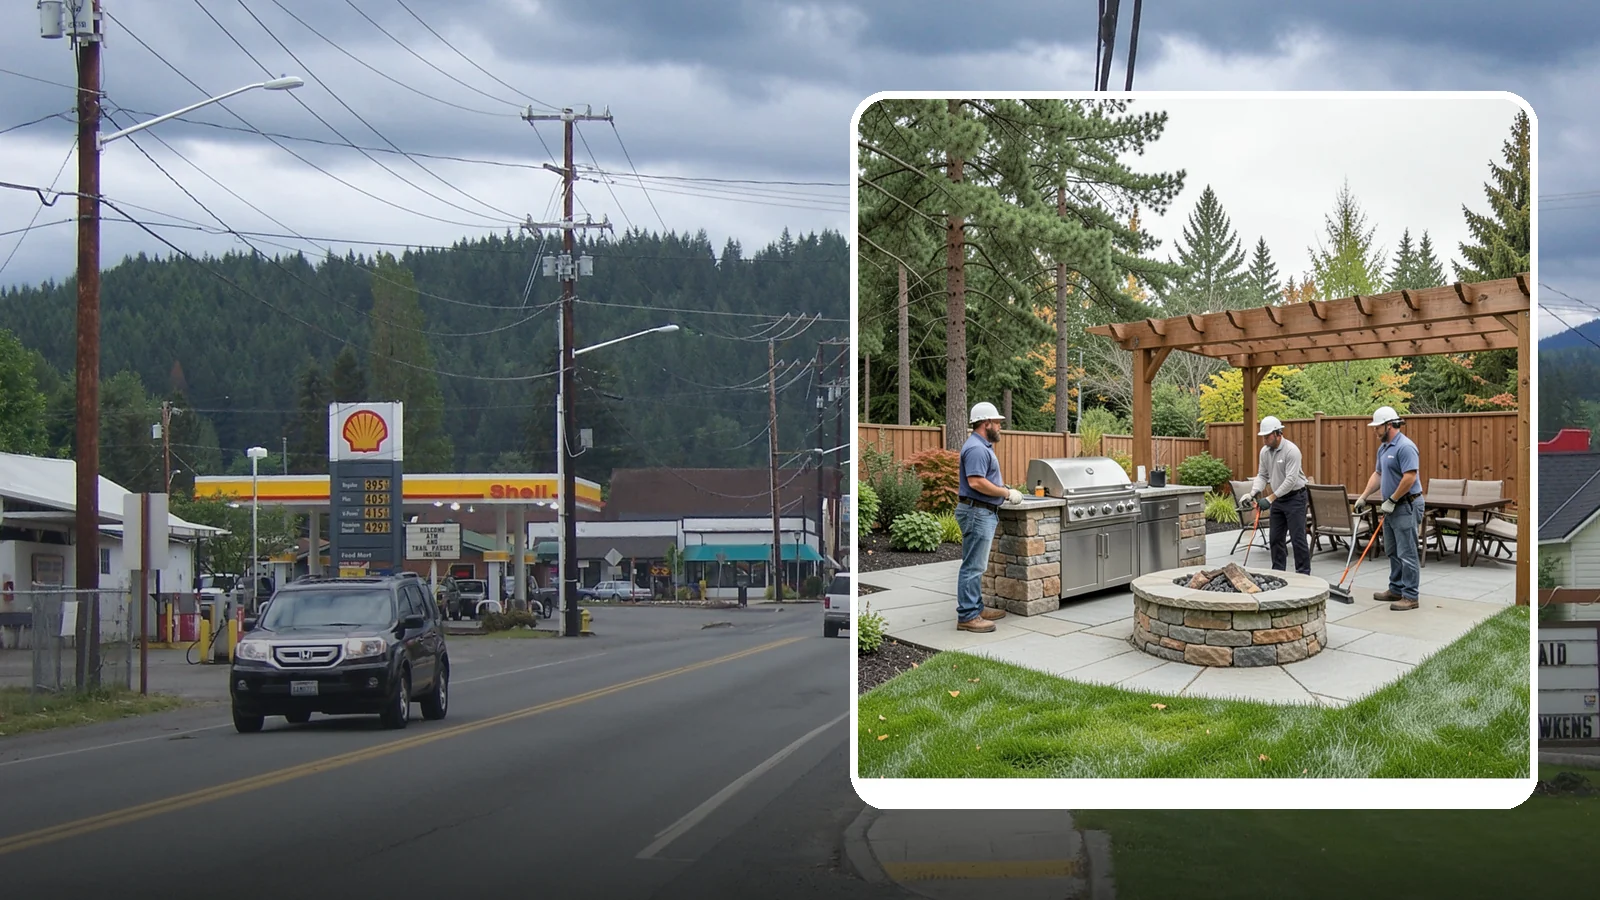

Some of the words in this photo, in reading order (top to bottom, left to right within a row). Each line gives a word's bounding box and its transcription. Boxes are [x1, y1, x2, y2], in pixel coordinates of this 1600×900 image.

[366, 480, 383, 490] 395
[490, 484, 547, 499] Shell
[366, 494, 383, 504] 405
[365, 508, 383, 518] 415
[366, 522, 383, 532] 429
[1539, 643, 1566, 666] AID
